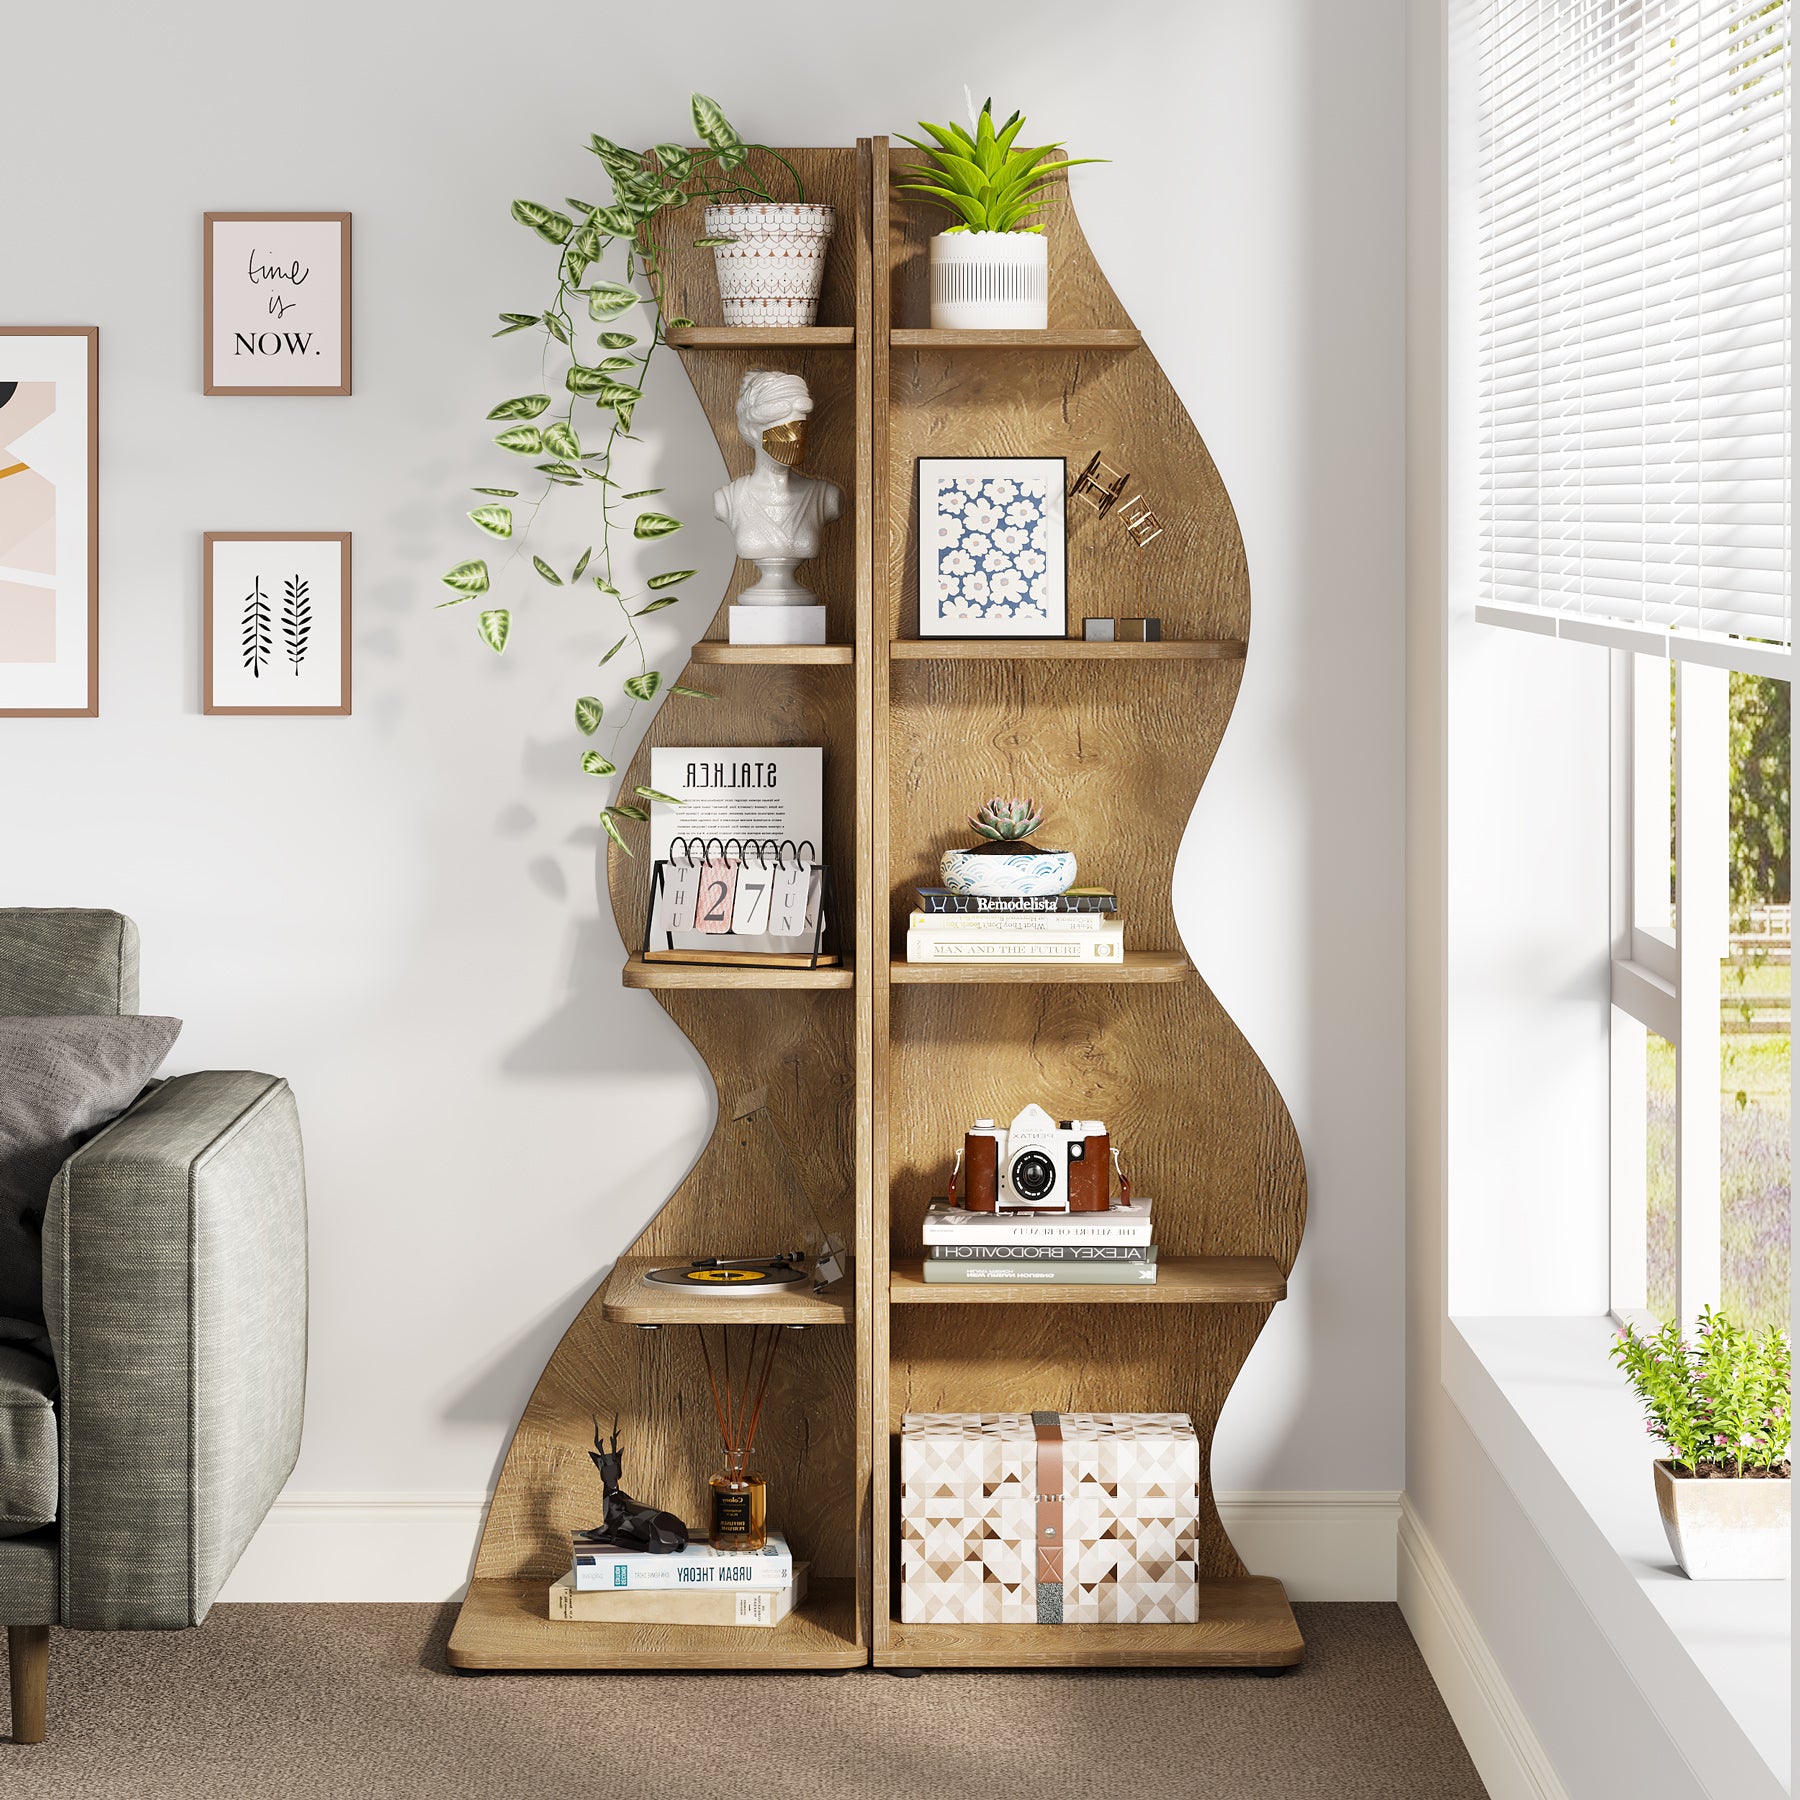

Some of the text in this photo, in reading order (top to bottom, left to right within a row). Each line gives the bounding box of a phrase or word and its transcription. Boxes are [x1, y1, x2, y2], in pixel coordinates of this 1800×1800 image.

[248, 249, 309, 285] time
[269, 289, 296, 319] is
[234, 332, 320, 356] NOW.
[977, 897, 1057, 911] Remodelista
[934, 945, 1081, 954] MAN AND THE FUTURE
